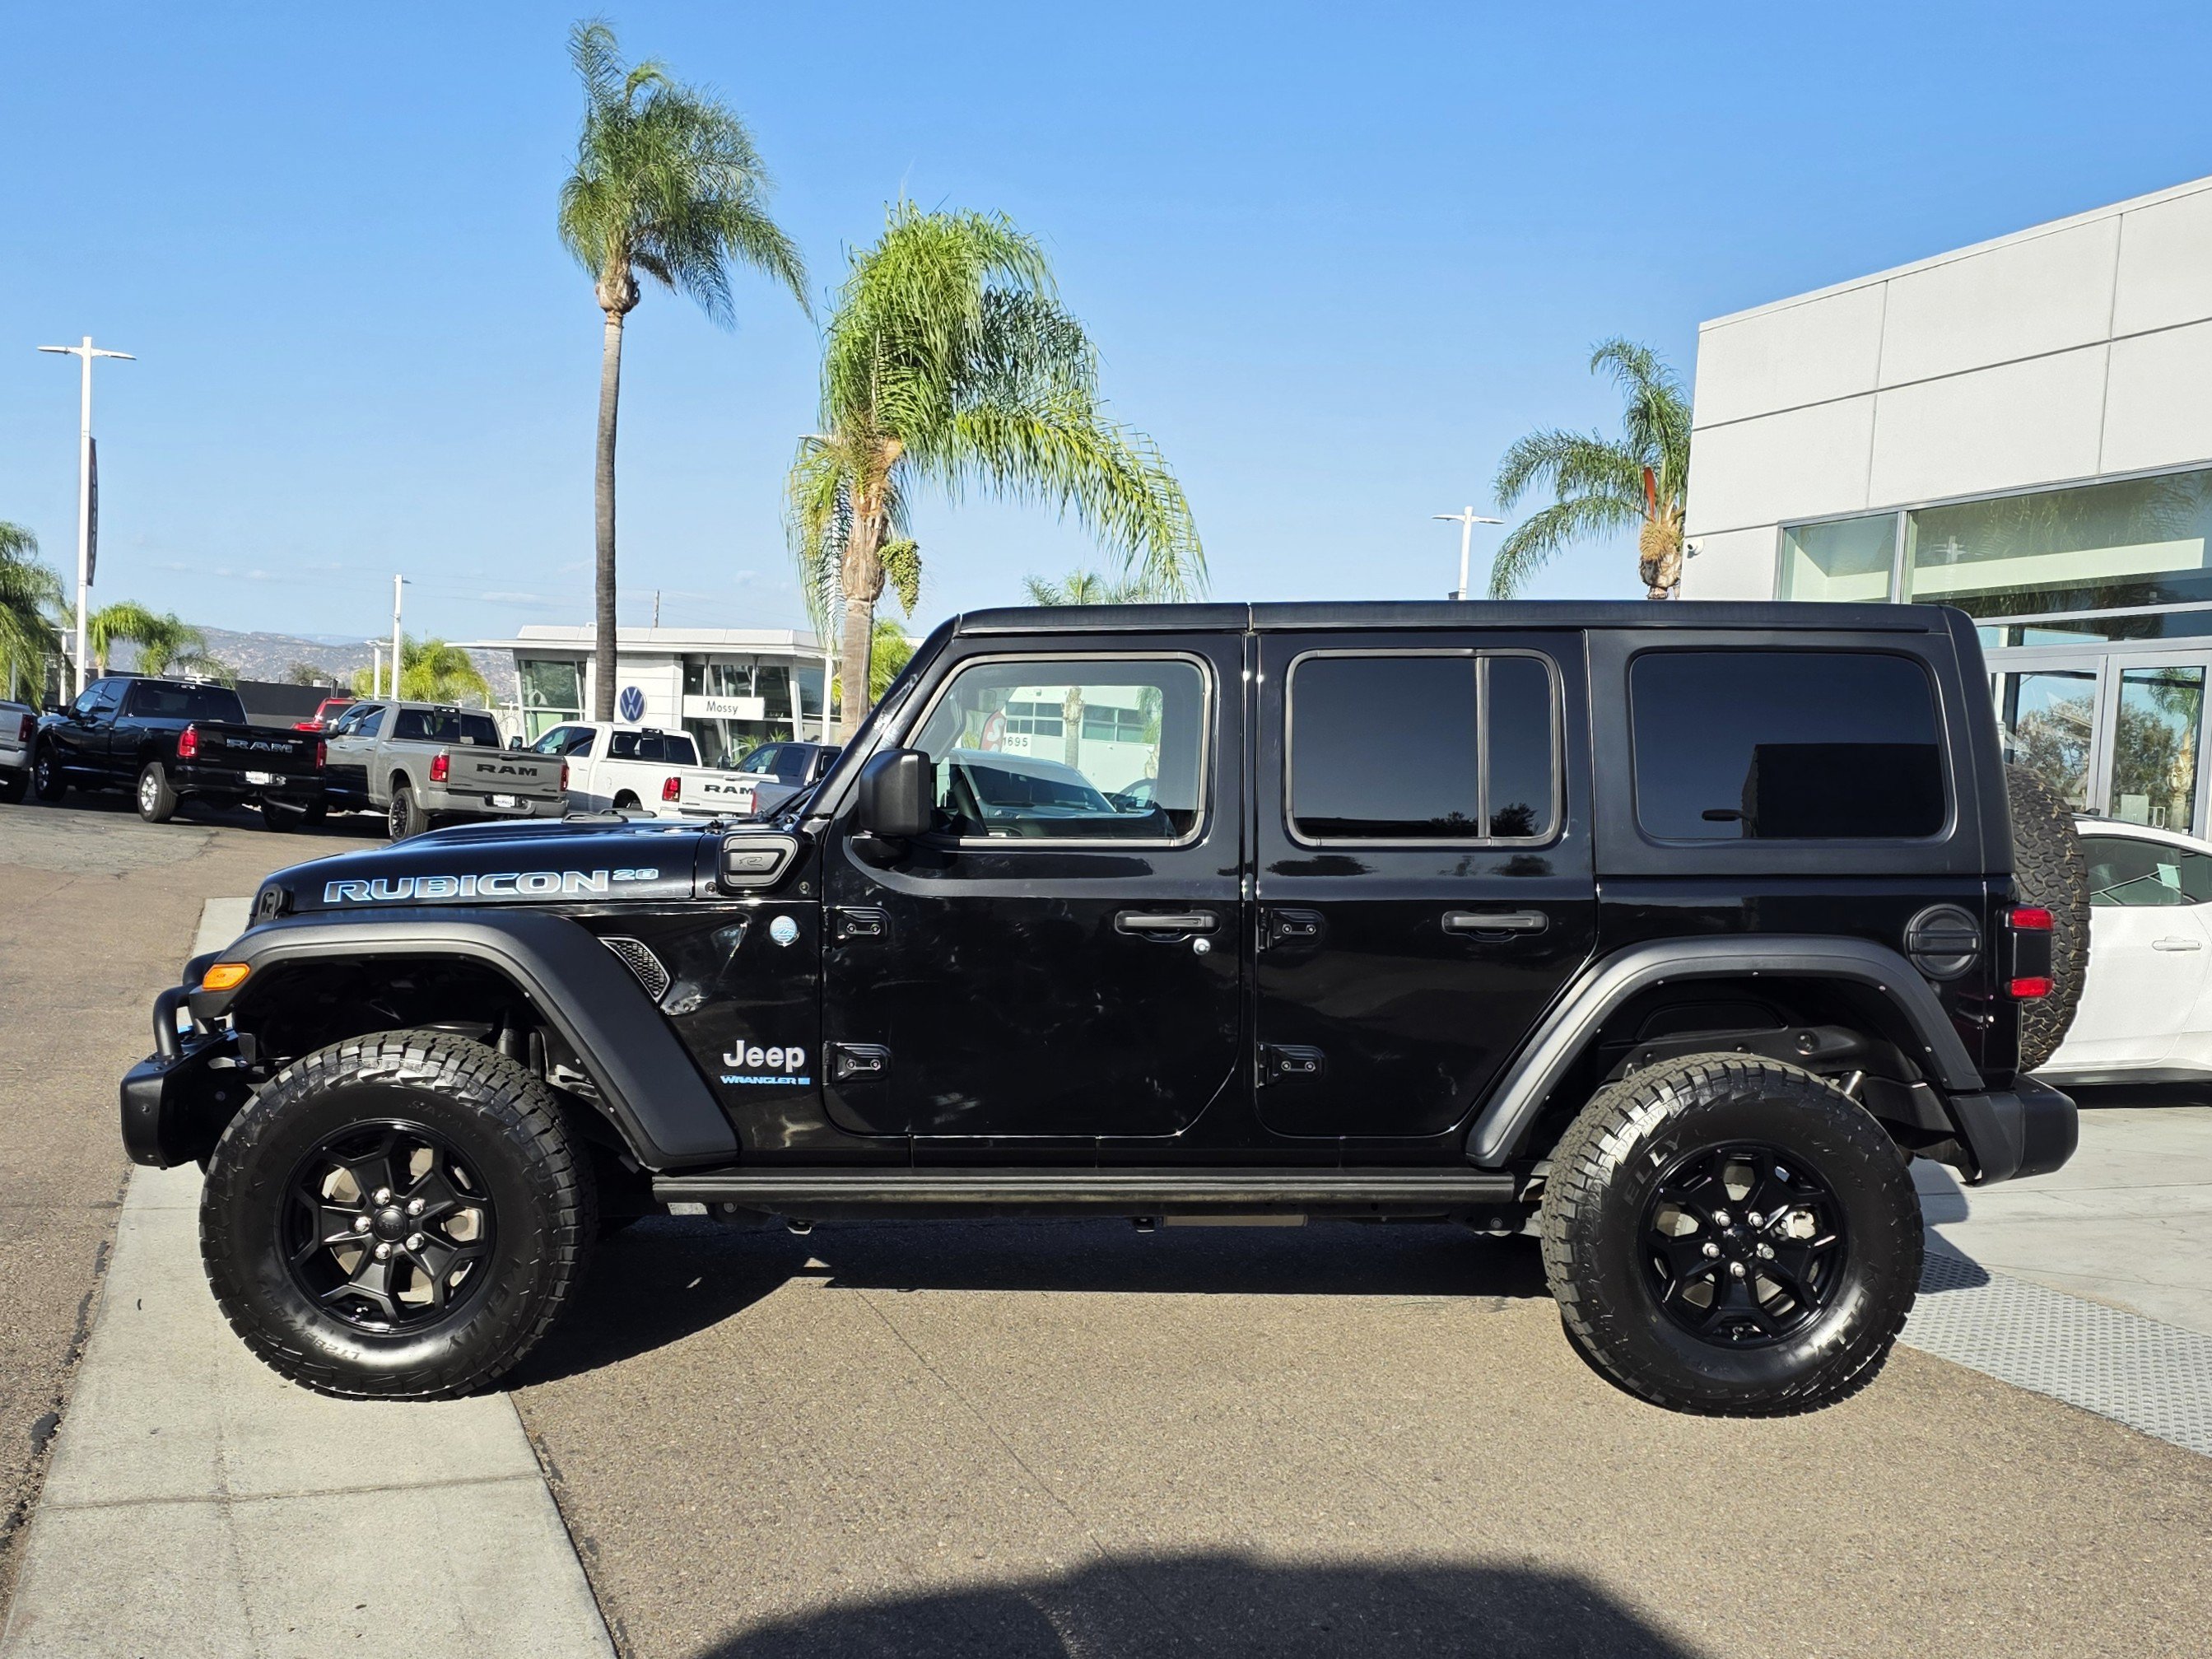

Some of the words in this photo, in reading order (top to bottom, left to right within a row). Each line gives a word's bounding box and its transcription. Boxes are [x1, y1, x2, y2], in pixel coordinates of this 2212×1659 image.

[706, 700, 739, 716] Mossy
[226, 738, 293, 753] RAM
[476, 763, 538, 776] RAM
[704, 784, 754, 795] RAM
[323, 869, 609, 903] RUBICON
[723, 1039, 806, 1074] Jeep
[719, 1075, 797, 1085] WRANGLER
